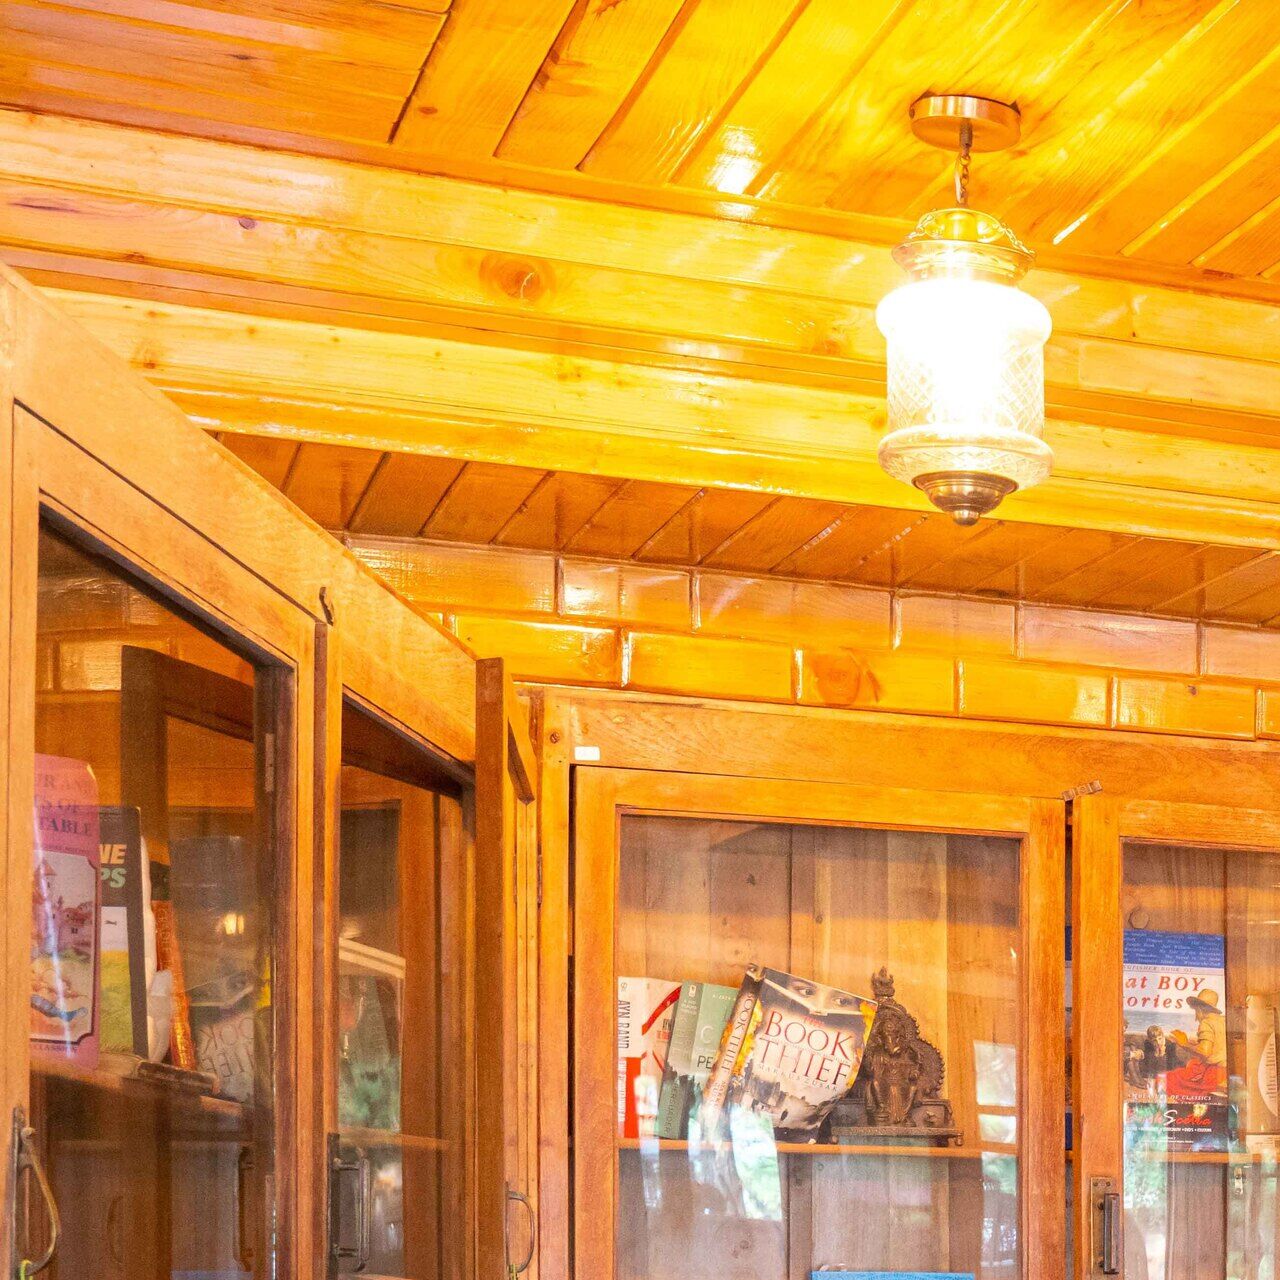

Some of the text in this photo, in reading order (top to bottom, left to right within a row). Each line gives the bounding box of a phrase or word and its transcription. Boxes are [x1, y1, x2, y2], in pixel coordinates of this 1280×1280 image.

[1125, 975, 1206, 991] at BOY
[1123, 995, 1184, 1009] ories
[618, 1000, 631, 1049] AYN RAND
[764, 1010, 854, 1061] BOOK
[697, 1055, 714, 1070] PE
[759, 1037, 851, 1086] THIEF
